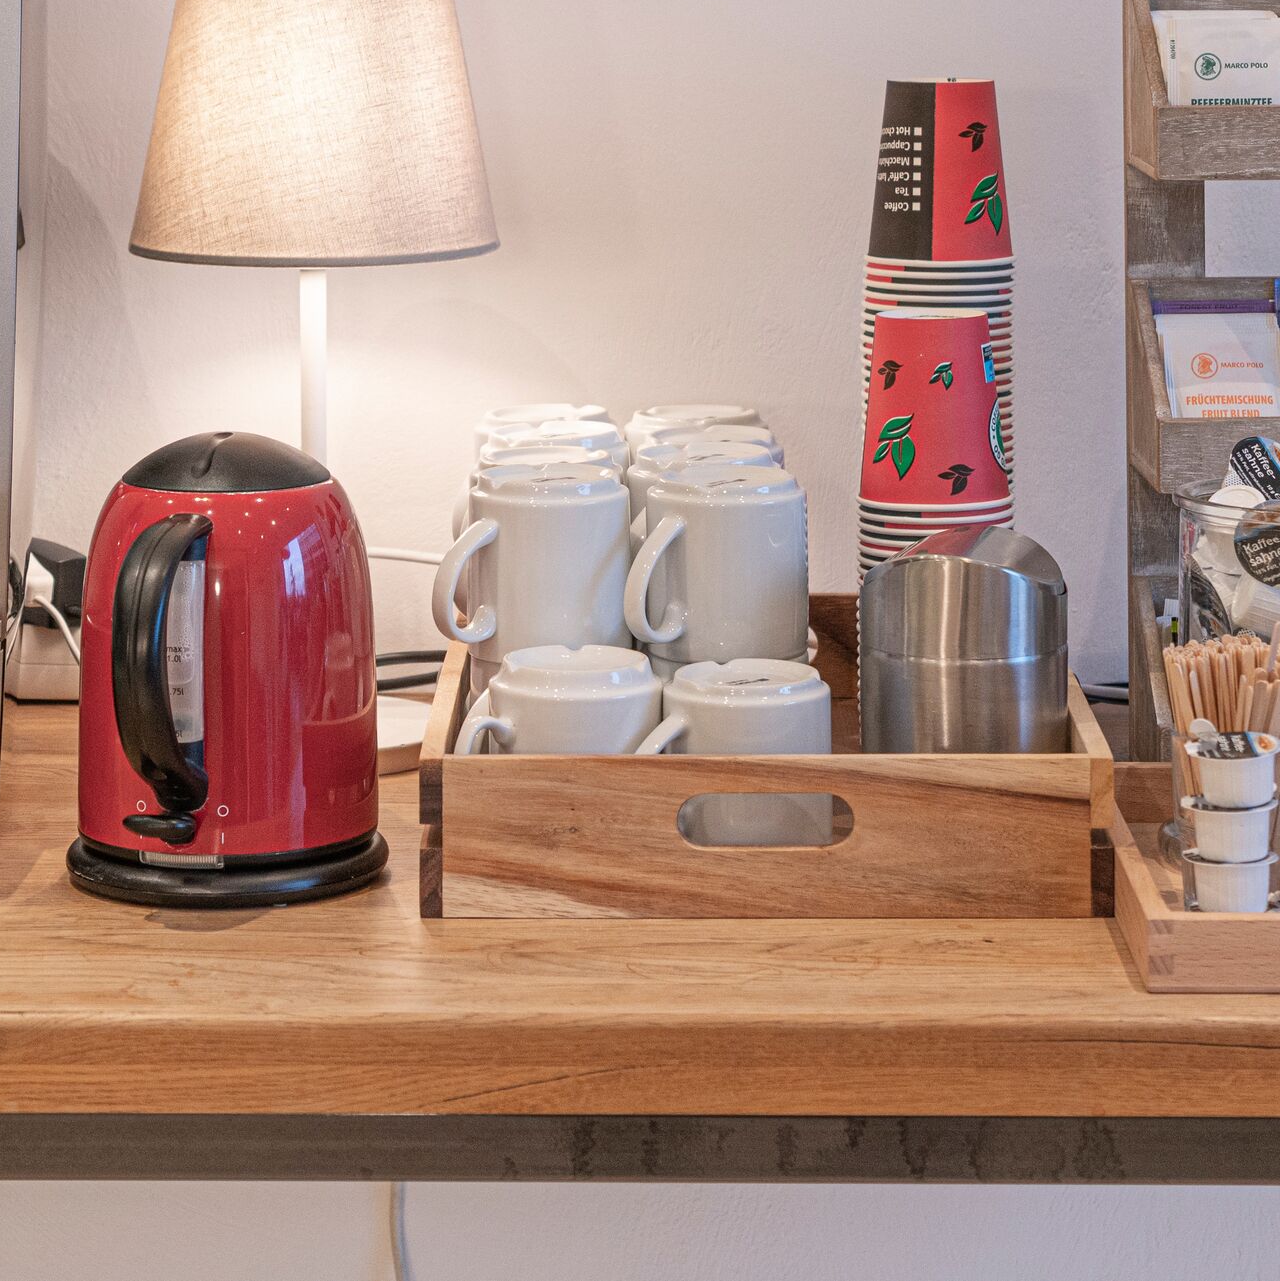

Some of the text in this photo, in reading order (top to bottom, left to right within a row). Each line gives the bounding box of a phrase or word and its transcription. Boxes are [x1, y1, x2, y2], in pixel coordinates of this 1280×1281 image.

[896, 126, 911, 136] Hot
[895, 187, 910, 196] Tea
[884, 202, 909, 212] Coffee
[1186, 394, 1274, 406] FRÜCHTEMISCHUNG
[1241, 448, 1265, 479] sahne
[1251, 443, 1276, 480] Kaffee-
